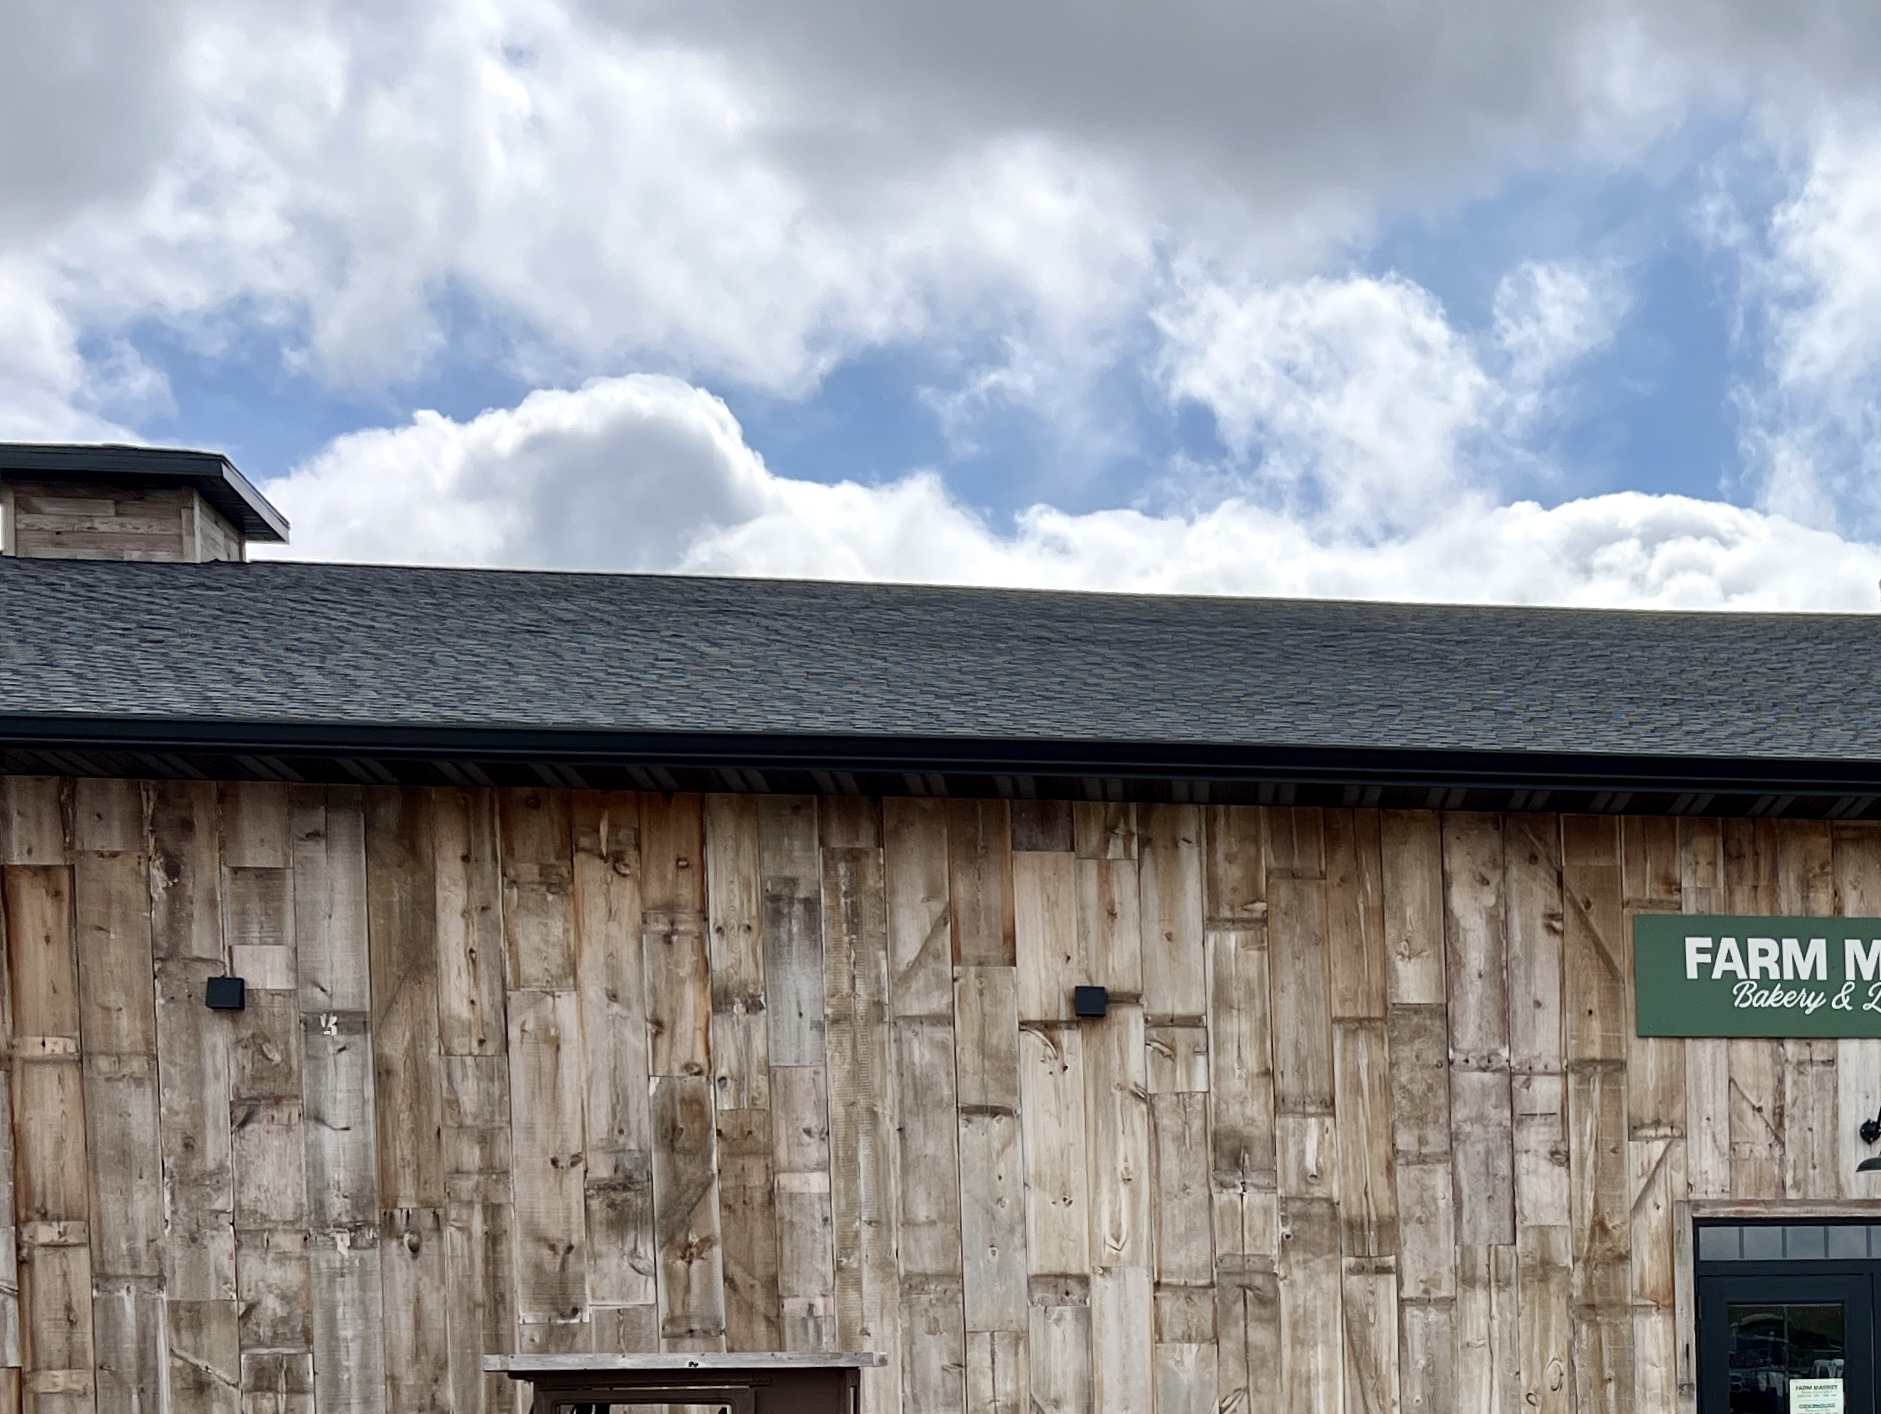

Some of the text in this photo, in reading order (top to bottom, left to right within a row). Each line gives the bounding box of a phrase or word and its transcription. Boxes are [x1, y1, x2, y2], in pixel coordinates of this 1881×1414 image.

[1684, 936, 1828, 981] FARM
[1732, 980, 1827, 1015] Bakery
[1831, 981, 1856, 1011] &
